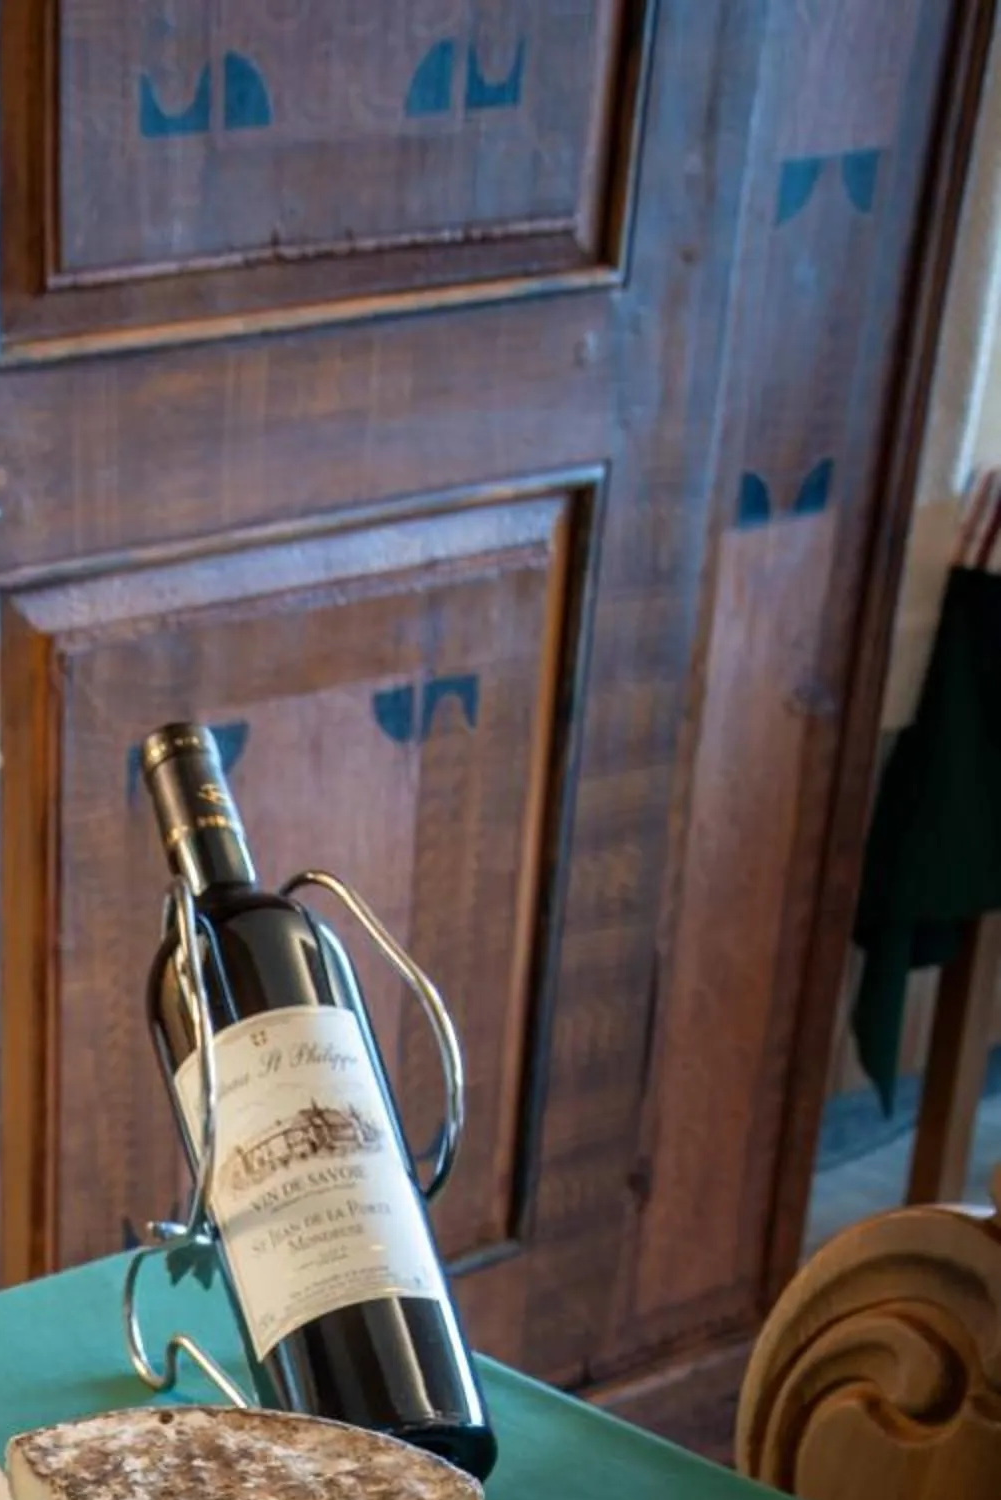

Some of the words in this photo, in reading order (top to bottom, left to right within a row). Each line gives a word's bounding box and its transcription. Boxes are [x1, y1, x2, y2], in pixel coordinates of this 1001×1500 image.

[251, 1190, 279, 1213] VIN
[281, 1177, 302, 1196] DE
[306, 1164, 365, 1186] SAVOIE
